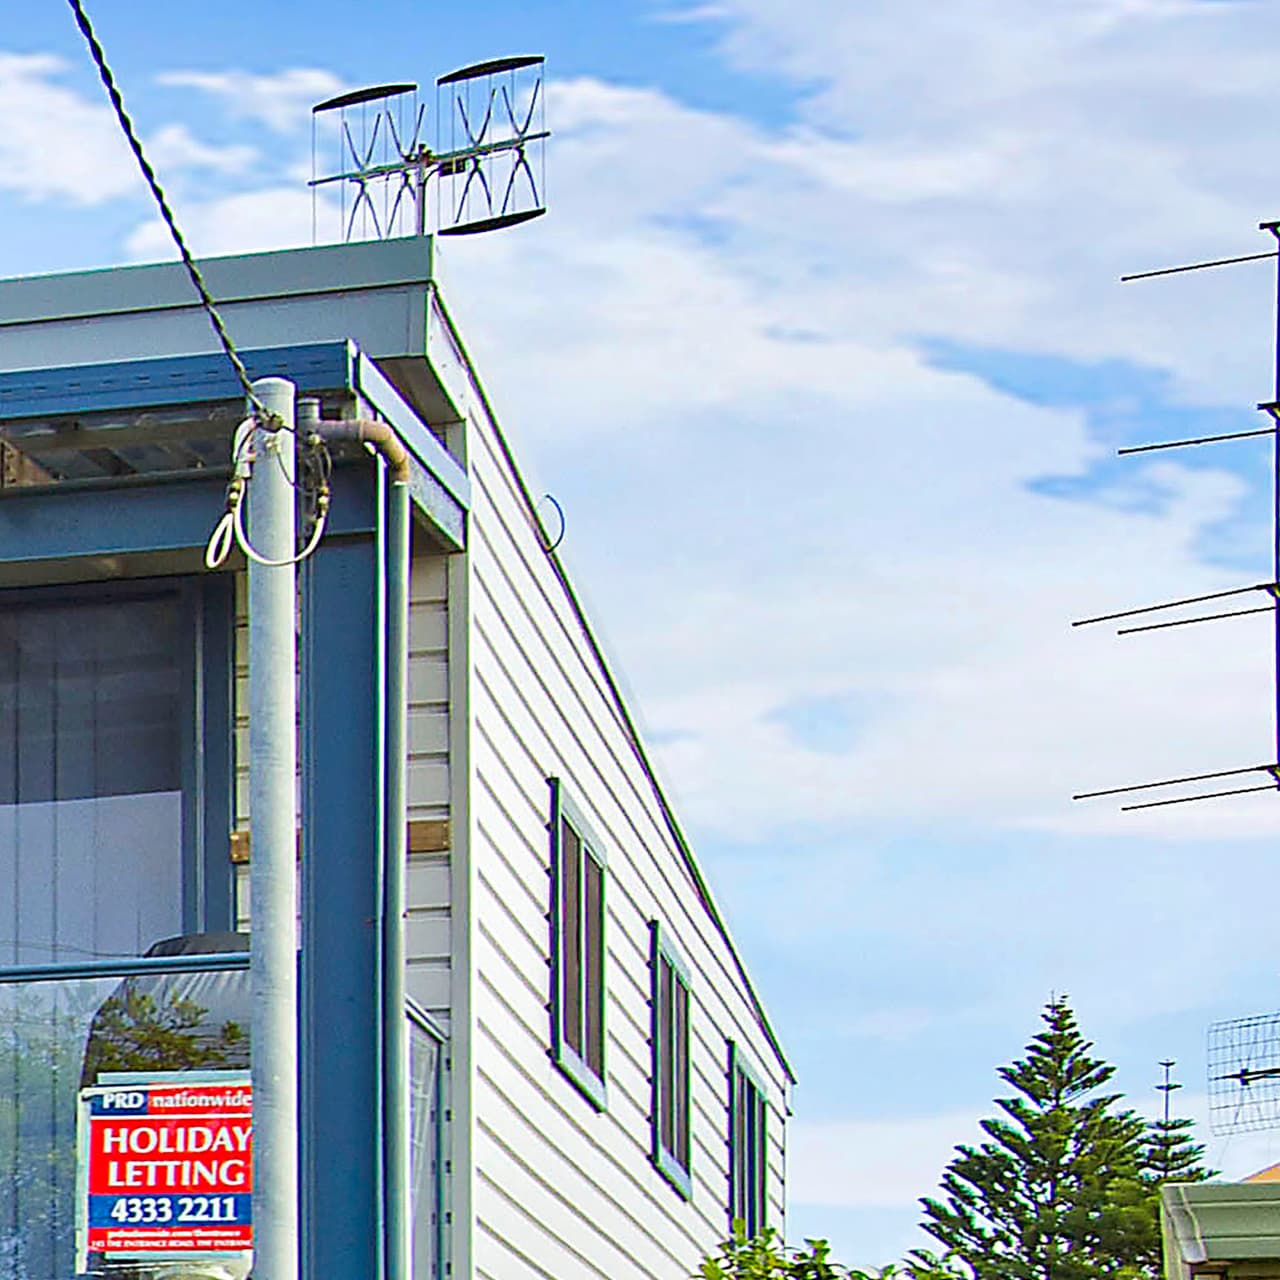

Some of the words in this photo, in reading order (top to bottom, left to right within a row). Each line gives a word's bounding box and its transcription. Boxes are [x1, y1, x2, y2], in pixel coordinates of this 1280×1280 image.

[102, 1092, 145, 1109] PRD
[152, 1090, 252, 1108] nationwide
[103, 1126, 252, 1153] HOLIDAY
[108, 1159, 245, 1186] LETTING
[111, 1198, 172, 1222] 4333
[177, 1197, 237, 1222] 2211
